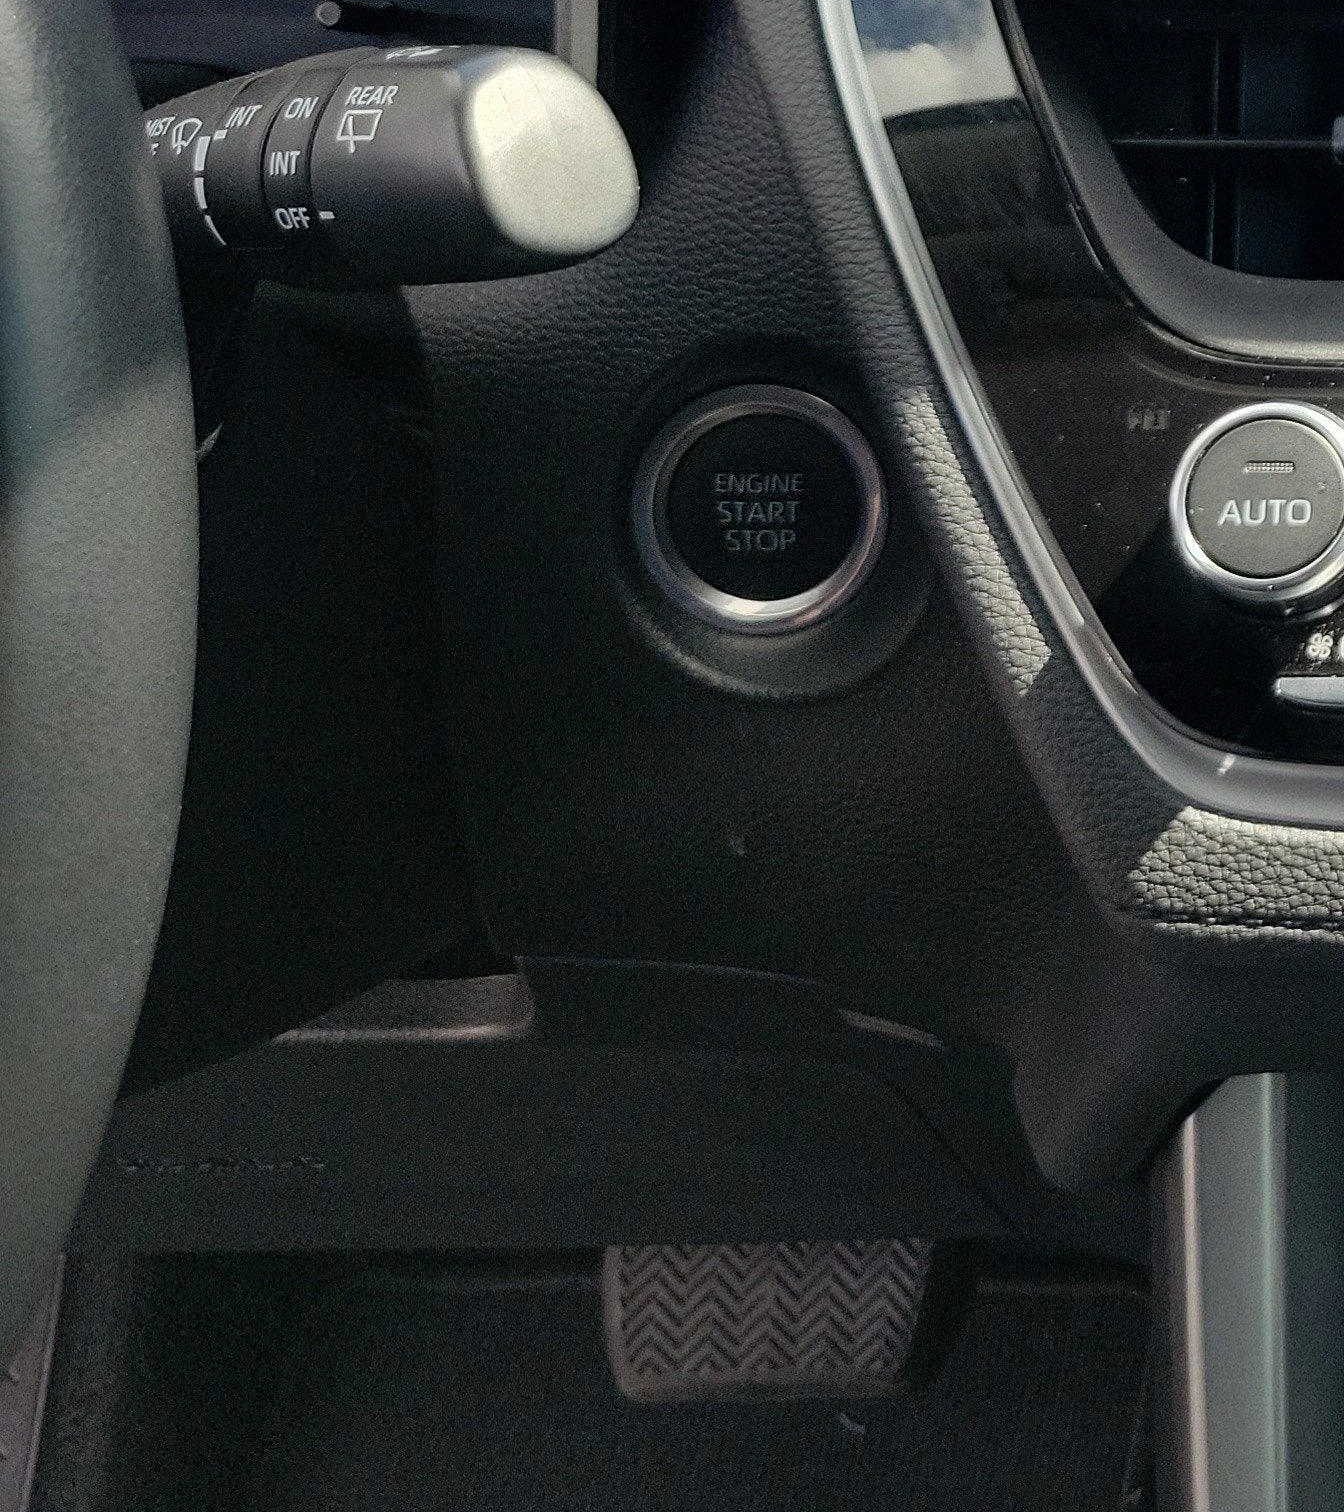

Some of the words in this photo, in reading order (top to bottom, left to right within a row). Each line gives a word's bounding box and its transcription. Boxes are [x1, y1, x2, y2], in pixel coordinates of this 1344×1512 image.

[284, 95, 320, 120] ON
[345, 85, 399, 106] REAR
[225, 104, 263, 129] INT
[268, 150, 302, 176] INT
[274, 206, 310, 230] OFF
[713, 472, 805, 495] ENGINE
[717, 500, 802, 525] START
[1217, 498, 1313, 528] AUTO
[725, 529, 797, 552] STOP
